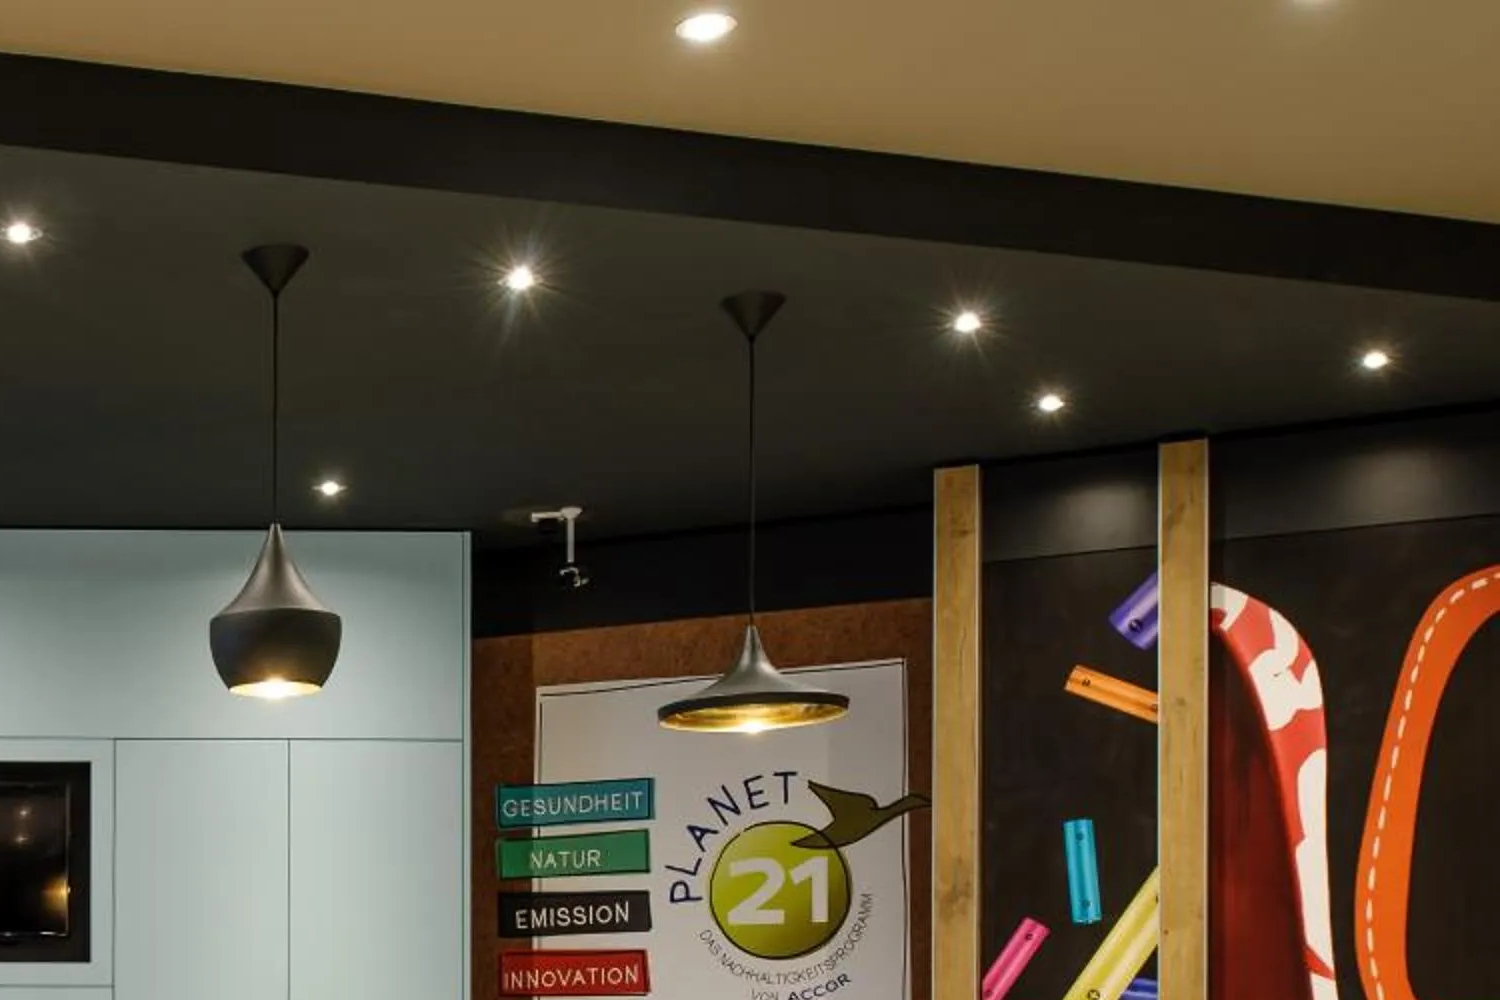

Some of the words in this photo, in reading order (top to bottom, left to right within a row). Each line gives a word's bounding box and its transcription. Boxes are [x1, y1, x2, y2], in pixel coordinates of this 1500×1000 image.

[502, 790, 644, 818] GESUNDHEIT
[665, 771, 799, 904] PLANET
[528, 847, 602, 870] NATUR
[726, 856, 831, 926] 21
[514, 900, 631, 930] EMISSION
[700, 929, 722, 956] DAS
[721, 892, 875, 985] NACHHALTIGKEITSPROGRAMM
[503, 963, 640, 991] INNOVATION
